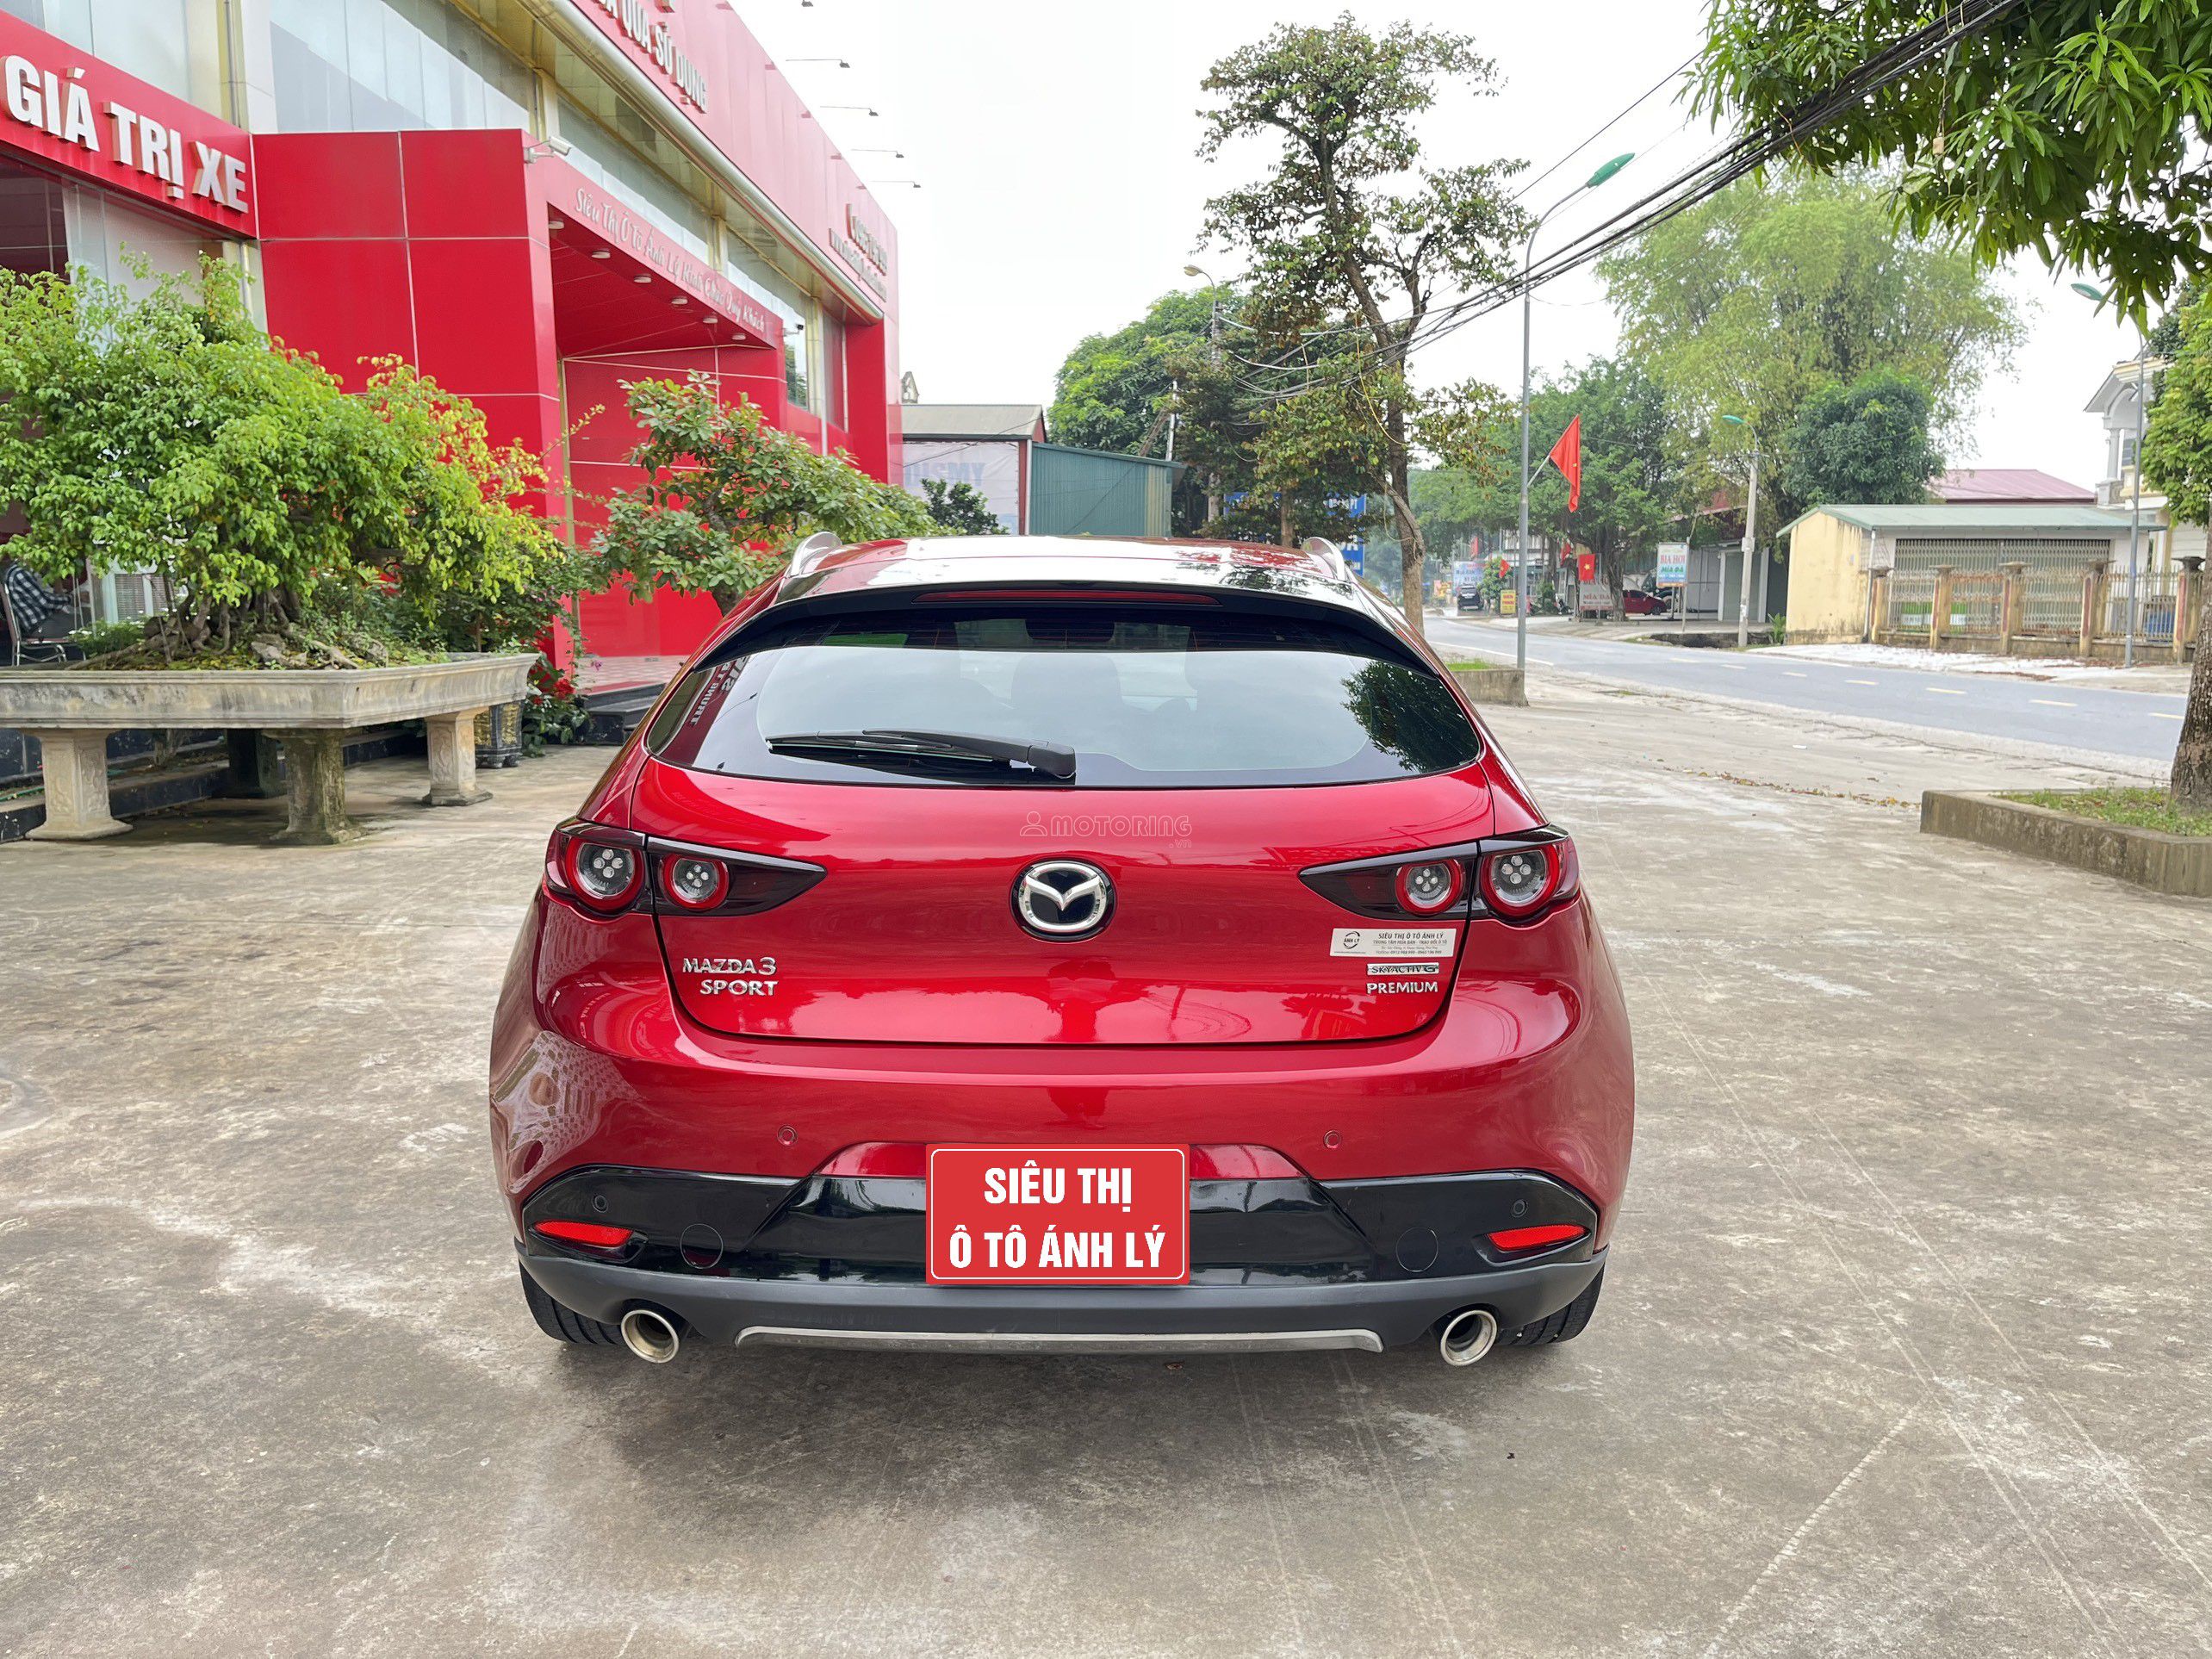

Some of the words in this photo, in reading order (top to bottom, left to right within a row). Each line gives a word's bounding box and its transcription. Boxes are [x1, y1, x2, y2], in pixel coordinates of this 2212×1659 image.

[2, 54, 100, 152] GIÁ
[104, 101, 184, 200] TRỊ
[190, 140, 249, 214] XE
[699, 979, 779, 996] SPORT
[1366, 981, 1438, 994] PREMIUM
